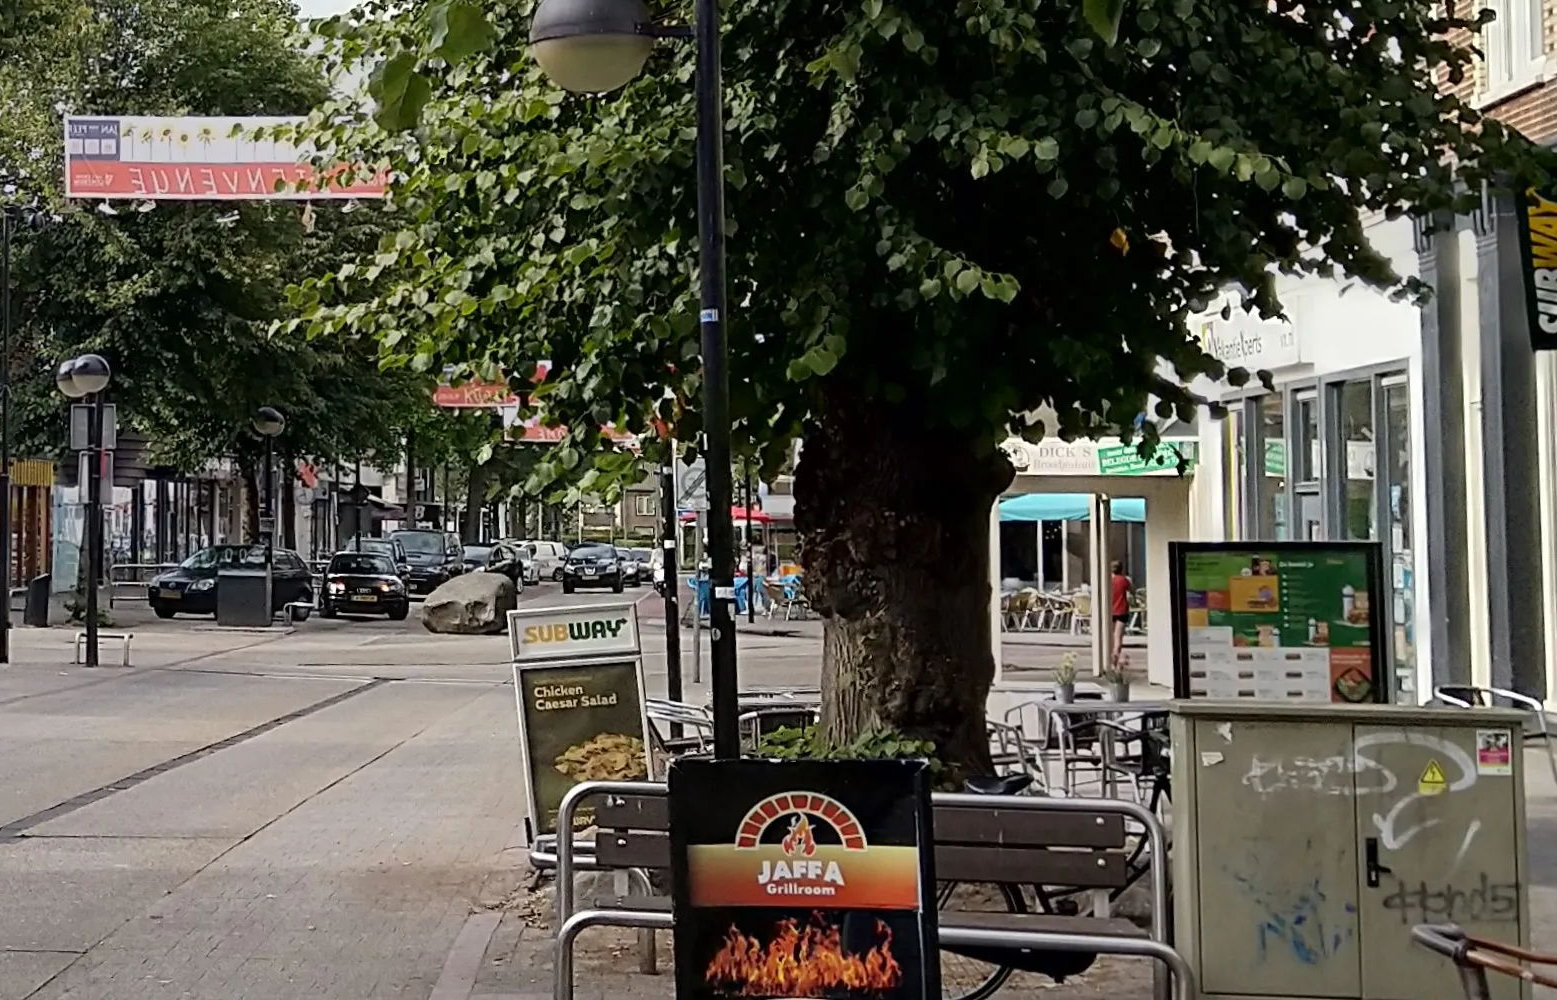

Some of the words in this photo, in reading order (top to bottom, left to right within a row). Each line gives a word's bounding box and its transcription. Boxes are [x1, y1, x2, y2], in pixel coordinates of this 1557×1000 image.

[522, 617, 628, 645] SUBWAY
[533, 684, 584, 698] Chicken
[535, 698, 578, 711] Caesar
[581, 693, 618, 707] Salad
[757, 860, 845, 886] JAFFA
[766, 883, 836, 896] Grillroom
